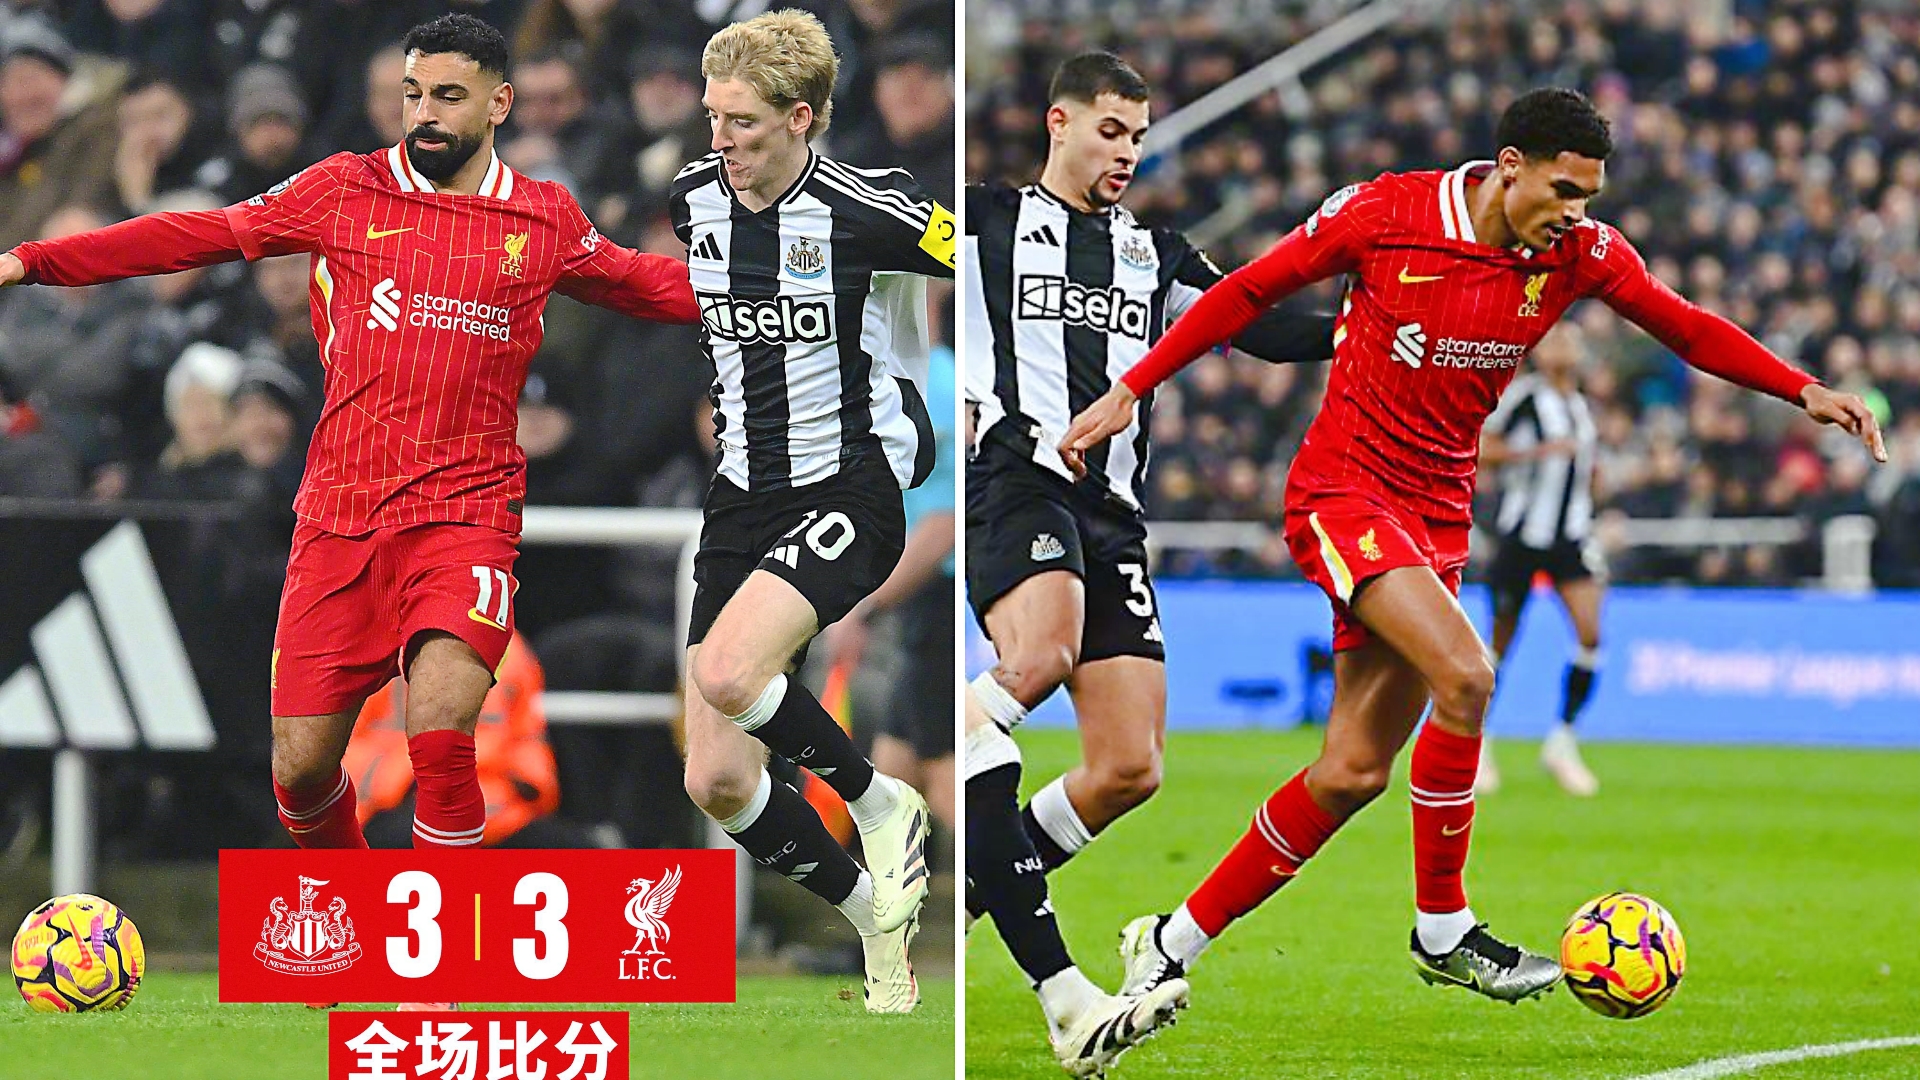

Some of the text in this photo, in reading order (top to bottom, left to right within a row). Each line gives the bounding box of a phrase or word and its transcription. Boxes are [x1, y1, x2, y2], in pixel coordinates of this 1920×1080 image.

[409, 309, 511, 342] chartered
[411, 291, 511, 324] standard
[734, 299, 827, 339] sela
[1063, 289, 1147, 337] sela
[783, 509, 856, 561] 10
[471, 565, 510, 627] 11
